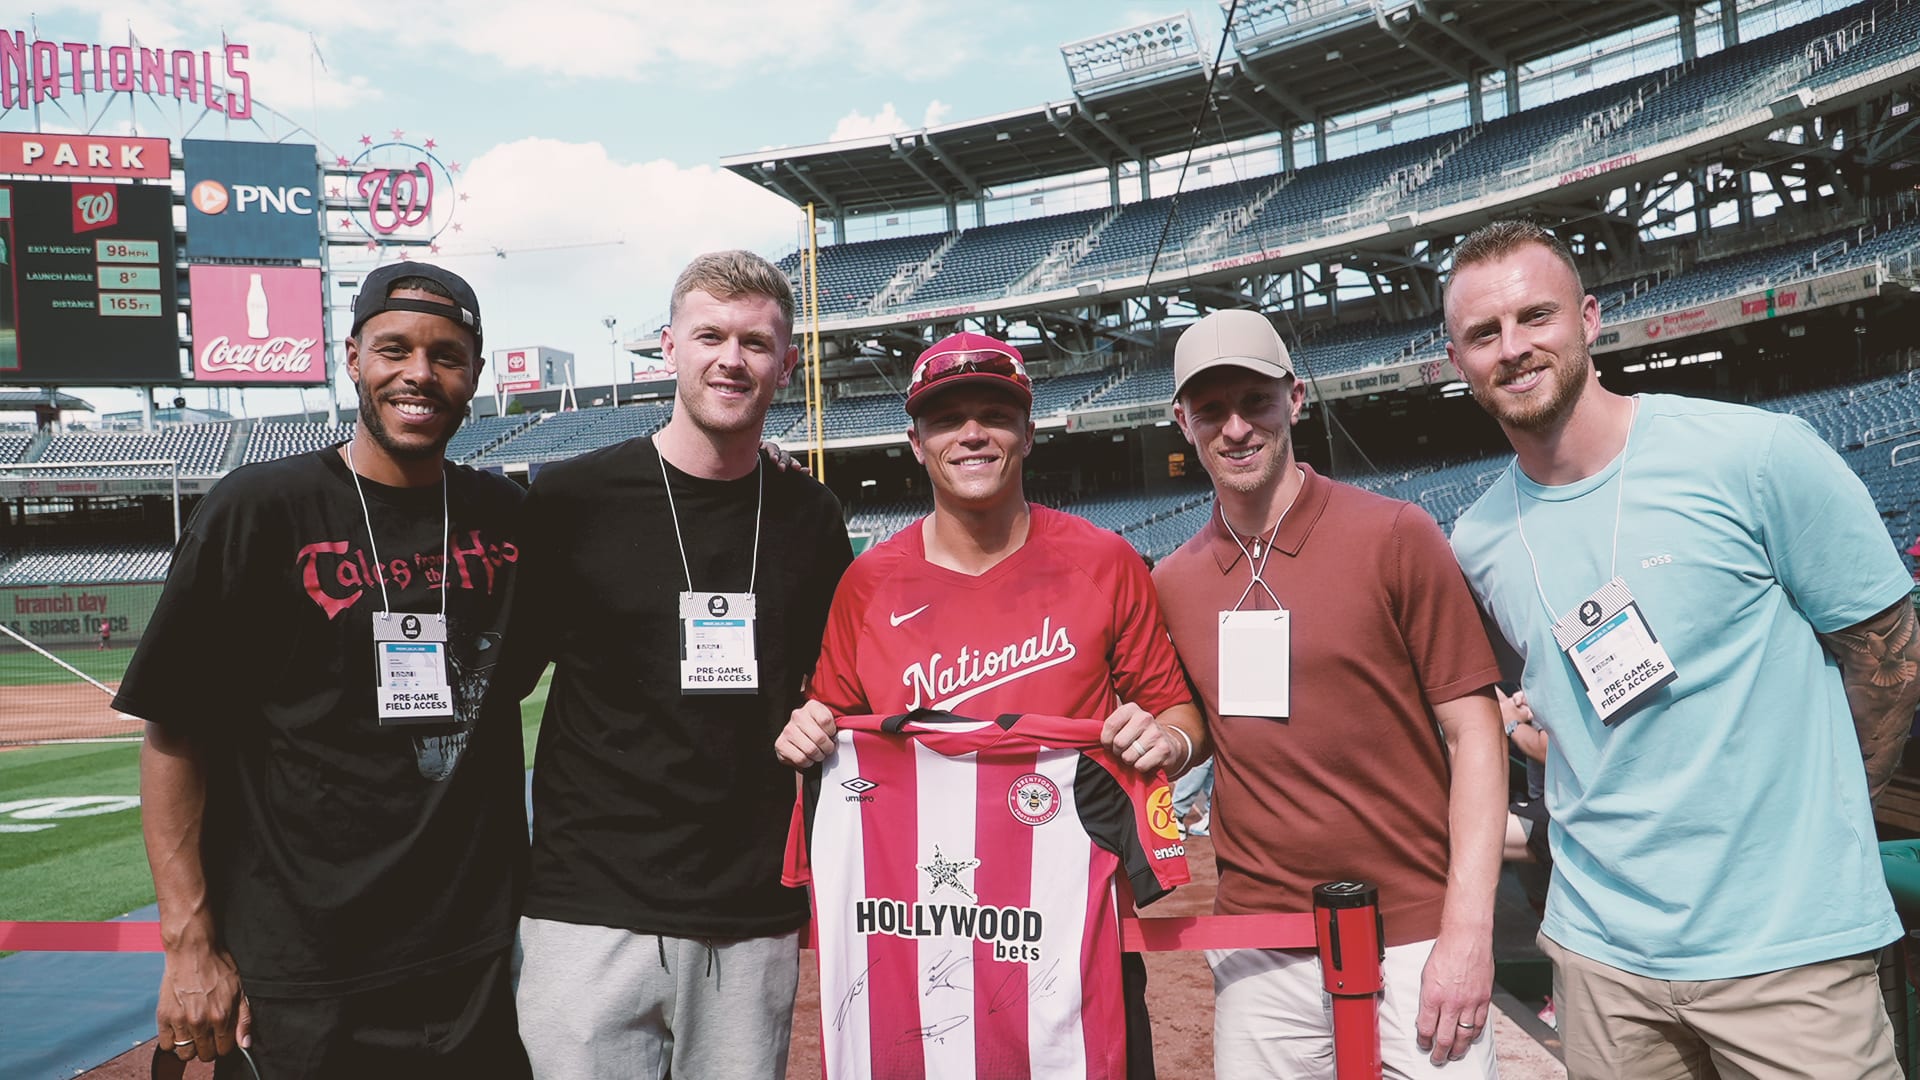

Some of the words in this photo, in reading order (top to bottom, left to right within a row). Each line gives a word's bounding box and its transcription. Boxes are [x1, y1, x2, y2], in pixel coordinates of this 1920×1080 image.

[0, 29, 252, 119] NATIONALS
[22, 141, 144, 169] PARK
[232, 184, 312, 214] PNC
[27, 245, 48, 253] EXIT
[50, 246, 92, 254] VELOCITY
[26, 272, 62, 280] LAUNCH
[64, 273, 93, 281] ANGLE
[52, 300, 95, 308] DISTANCE
[1778, 291, 1797, 308] day
[201, 335, 317, 373] Coca-Cola
[1641, 554, 1672, 569] BOSS
[296, 541, 412, 621] Tales
[15, 592, 73, 614] branch
[78, 592, 107, 613] day
[29, 618, 80, 637] space
[82, 614, 129, 633] foce
[902, 616, 1076, 712] Nationals
[1601, 687, 1627, 710] FIELD
[1628, 661, 1665, 691] ACCESS
[1603, 658, 1653, 697] PRE-GAME
[385, 702, 411, 710] FIELD
[414, 701, 448, 710] ACCESS
[393, 693, 439, 701] PRE-GAME
[1015, 777, 1054, 792] BRENTFORD
[845, 794, 875, 802] umbro
[1153, 844, 1185, 860] ensio
[856, 900, 1043, 943] HOLLYWOOD
[996, 940, 1041, 962] bets
